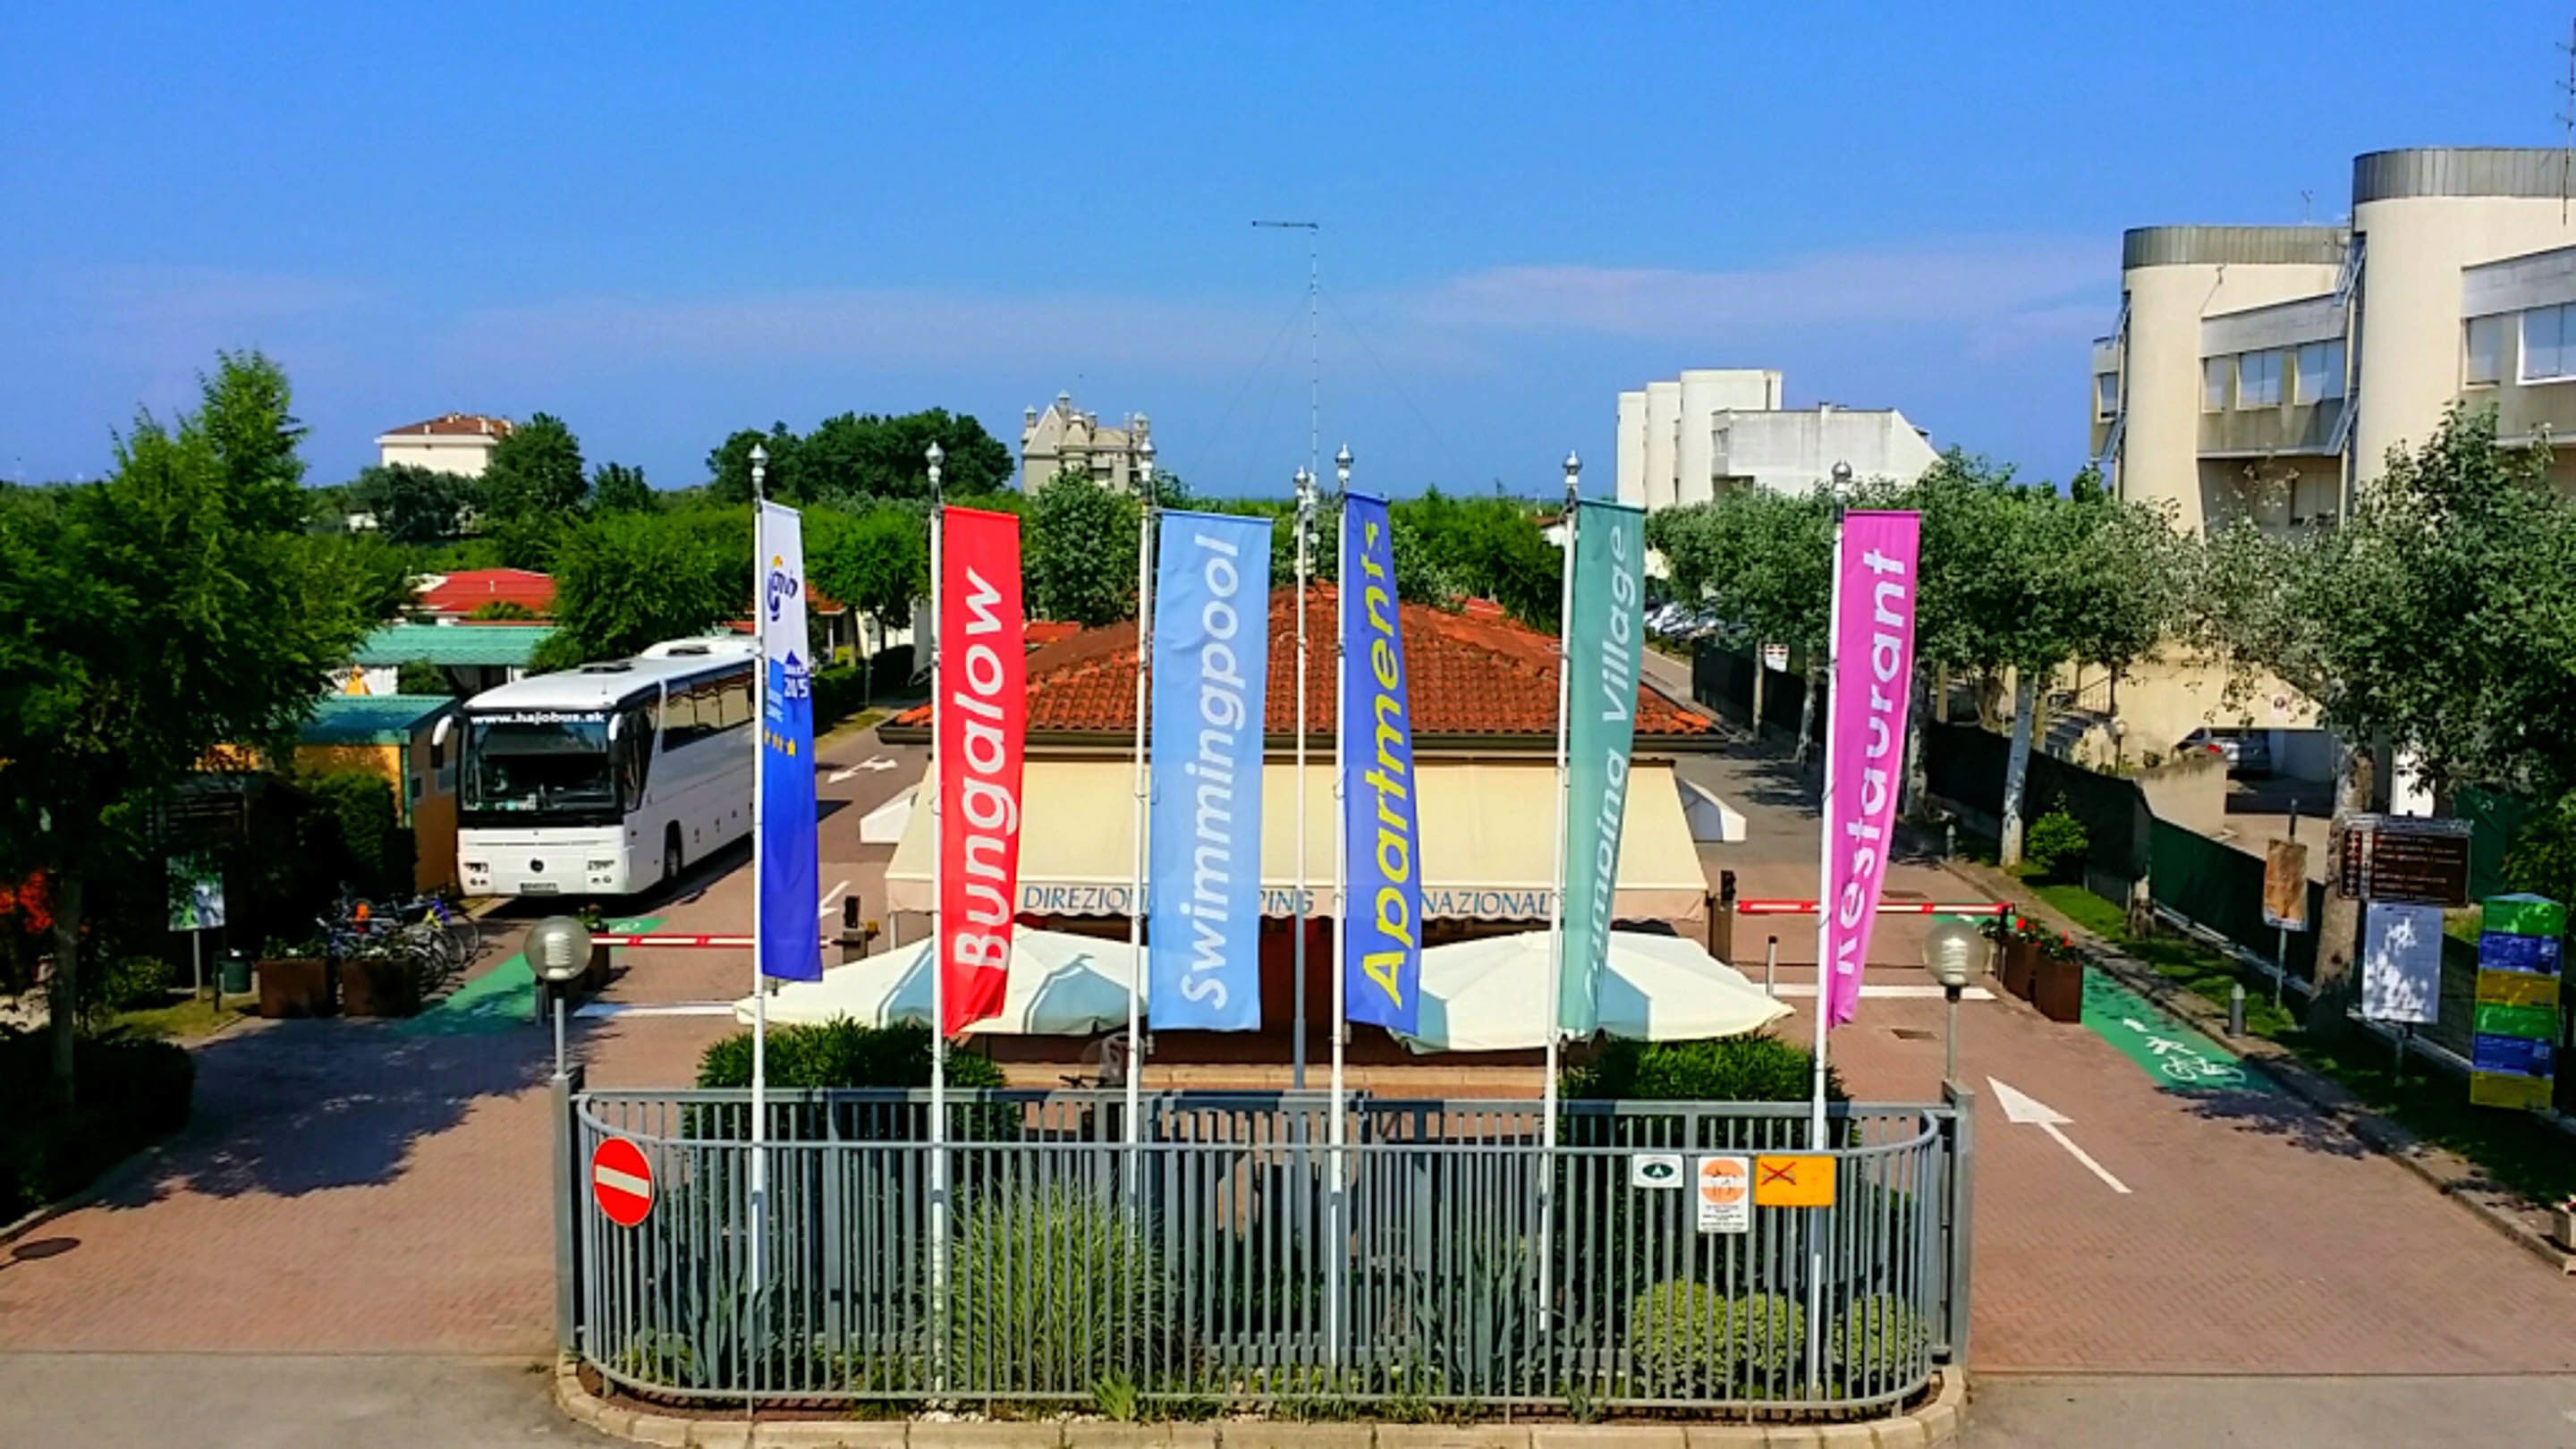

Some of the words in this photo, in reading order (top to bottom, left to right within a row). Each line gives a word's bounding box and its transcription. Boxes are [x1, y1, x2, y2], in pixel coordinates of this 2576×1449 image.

[470, 711, 606, 725] www.hajobus.sk
[954, 565, 1018, 972] Bungalow
[1180, 533, 1246, 1011] Swimmingpool
[1602, 524, 1638, 722] Village
